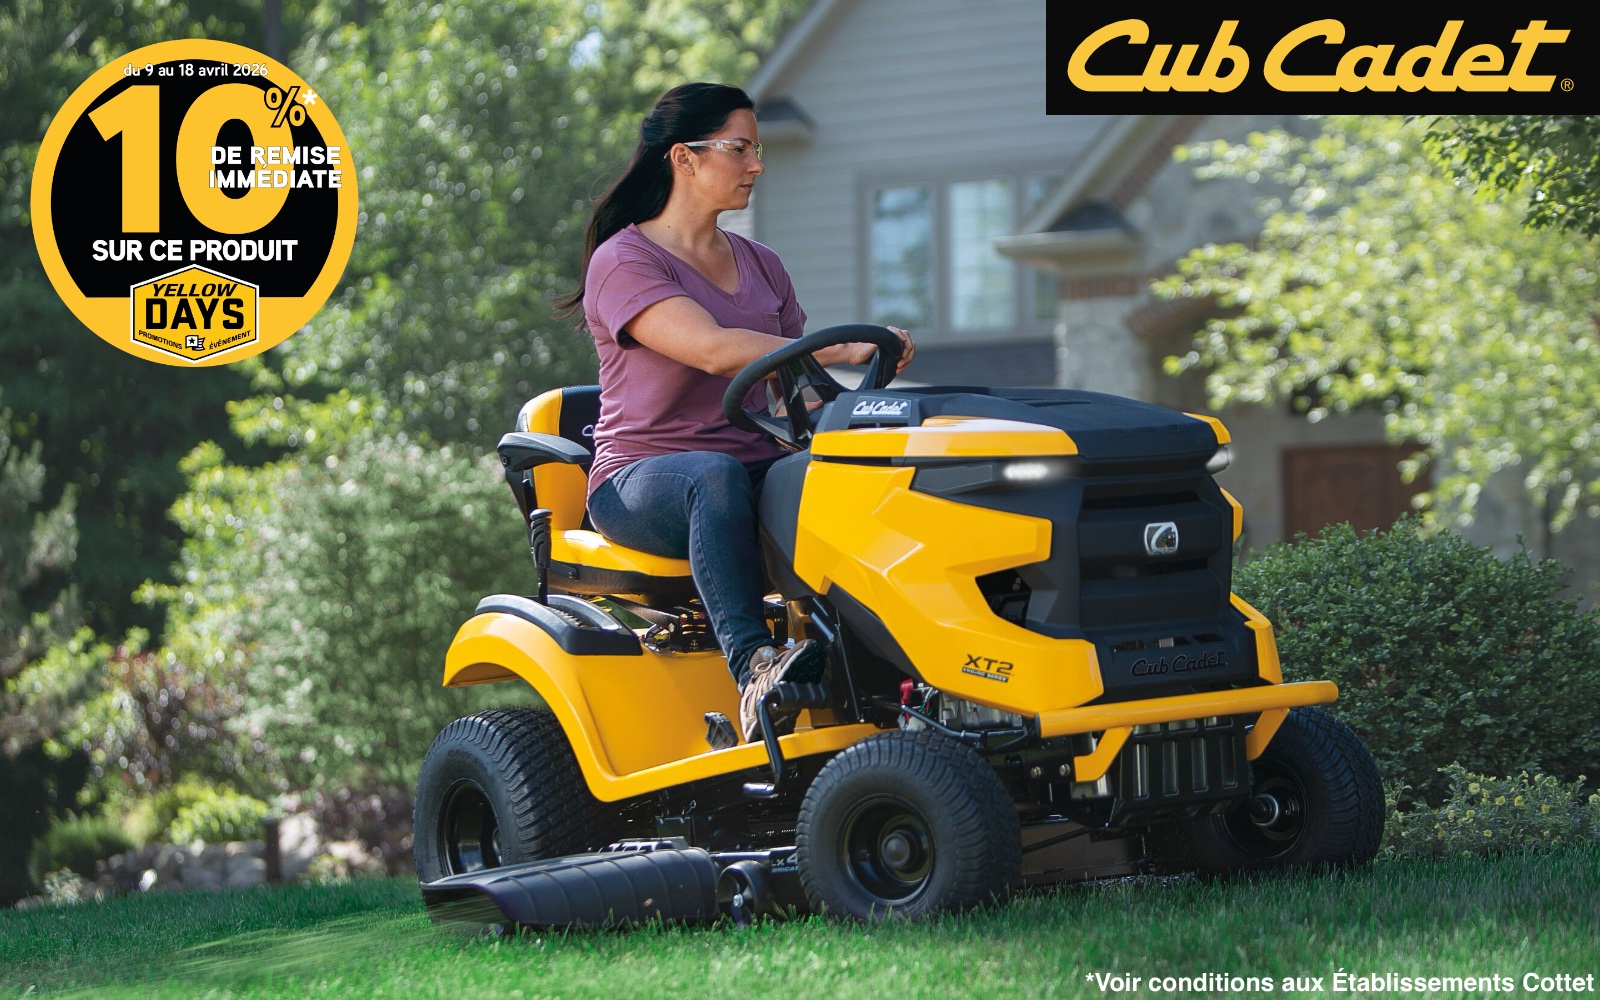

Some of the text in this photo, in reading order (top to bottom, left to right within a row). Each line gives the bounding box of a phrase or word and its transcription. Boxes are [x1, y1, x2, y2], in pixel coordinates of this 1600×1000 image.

[852, 401, 908, 415] Cub Cadet
[964, 653, 1013, 675] XT2
[1131, 649, 1226, 677] Cub Cadet
[786, 852, 799, 865] 4
